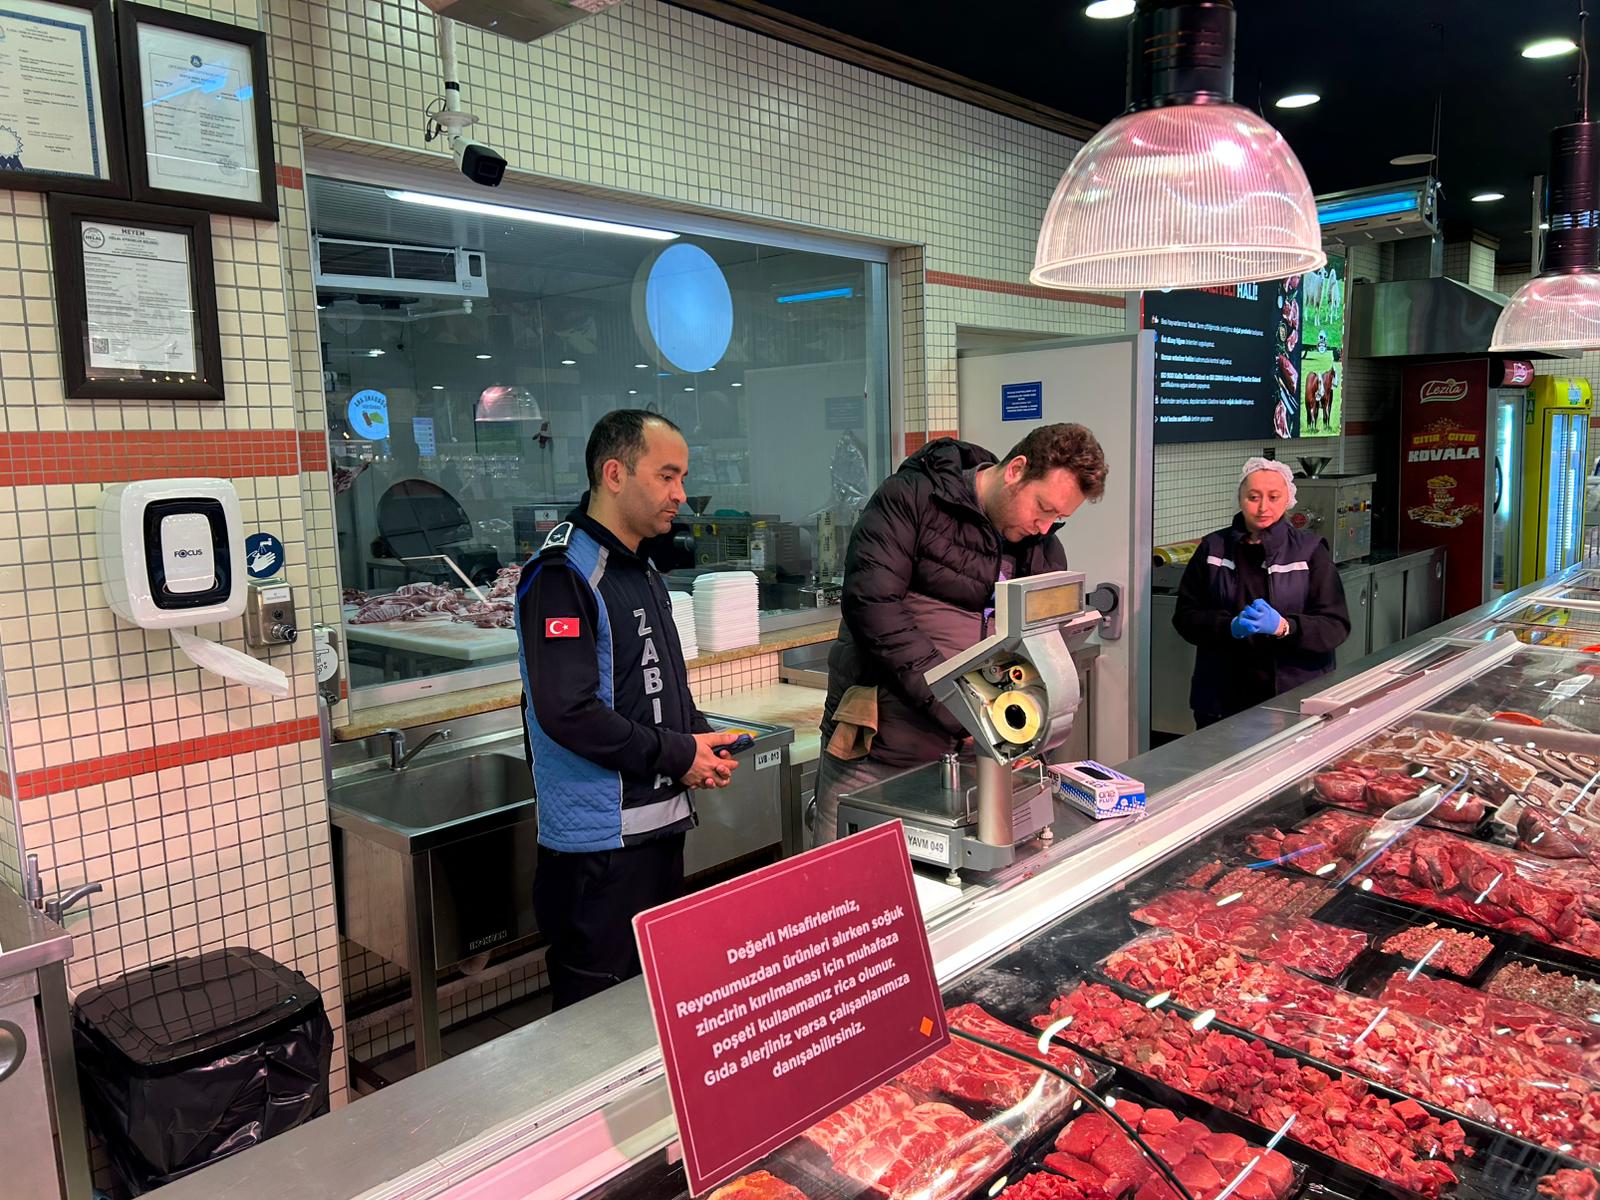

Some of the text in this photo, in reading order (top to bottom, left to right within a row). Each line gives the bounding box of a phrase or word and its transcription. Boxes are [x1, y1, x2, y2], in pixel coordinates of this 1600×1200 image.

[1408, 446, 1480, 462] KOVALA
[174, 549, 203, 559] FOCUS
[1098, 789, 1116, 799] one
[907, 834, 944, 854] YAVM 049
[676, 905, 905, 1018] Reyonumuzdan ürünleri alırken soğuk
[726, 899, 860, 965] Değerli Misafirlerimiz,
[695, 932, 899, 1037] zincirin kırılmaması için muhafaza
[712, 957, 896, 1059] poşeti kullanmanız rica olunur.
[704, 973, 911, 1086] Gıda alerjiniz varsa çalışanlarımıza
[772, 1020, 866, 1078] danışabilirsiniz.
